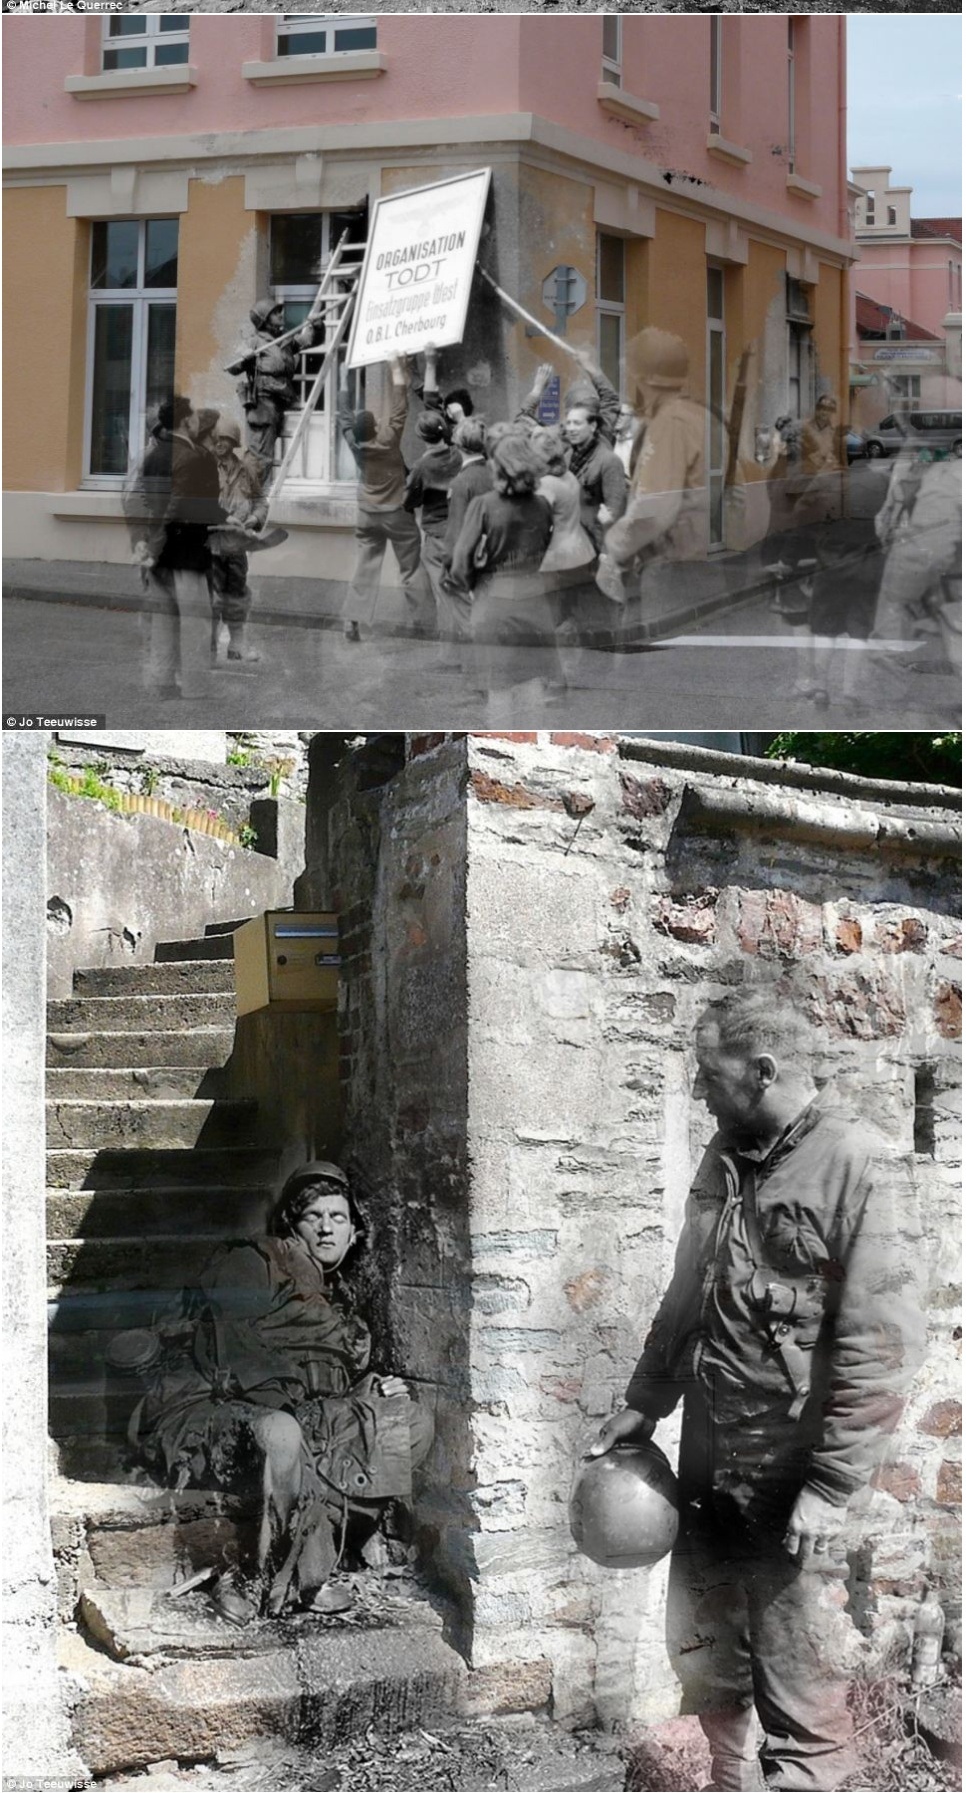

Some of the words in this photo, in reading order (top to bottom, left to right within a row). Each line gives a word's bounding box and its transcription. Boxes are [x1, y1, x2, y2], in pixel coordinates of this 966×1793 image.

[376, 230, 466, 271] ORGANISATION
[385, 258, 447, 288] TODT
[366, 291, 431, 322] Einsatzgruppe
[432, 277, 458, 305] West
[394, 314, 447, 337] Cherbourg
